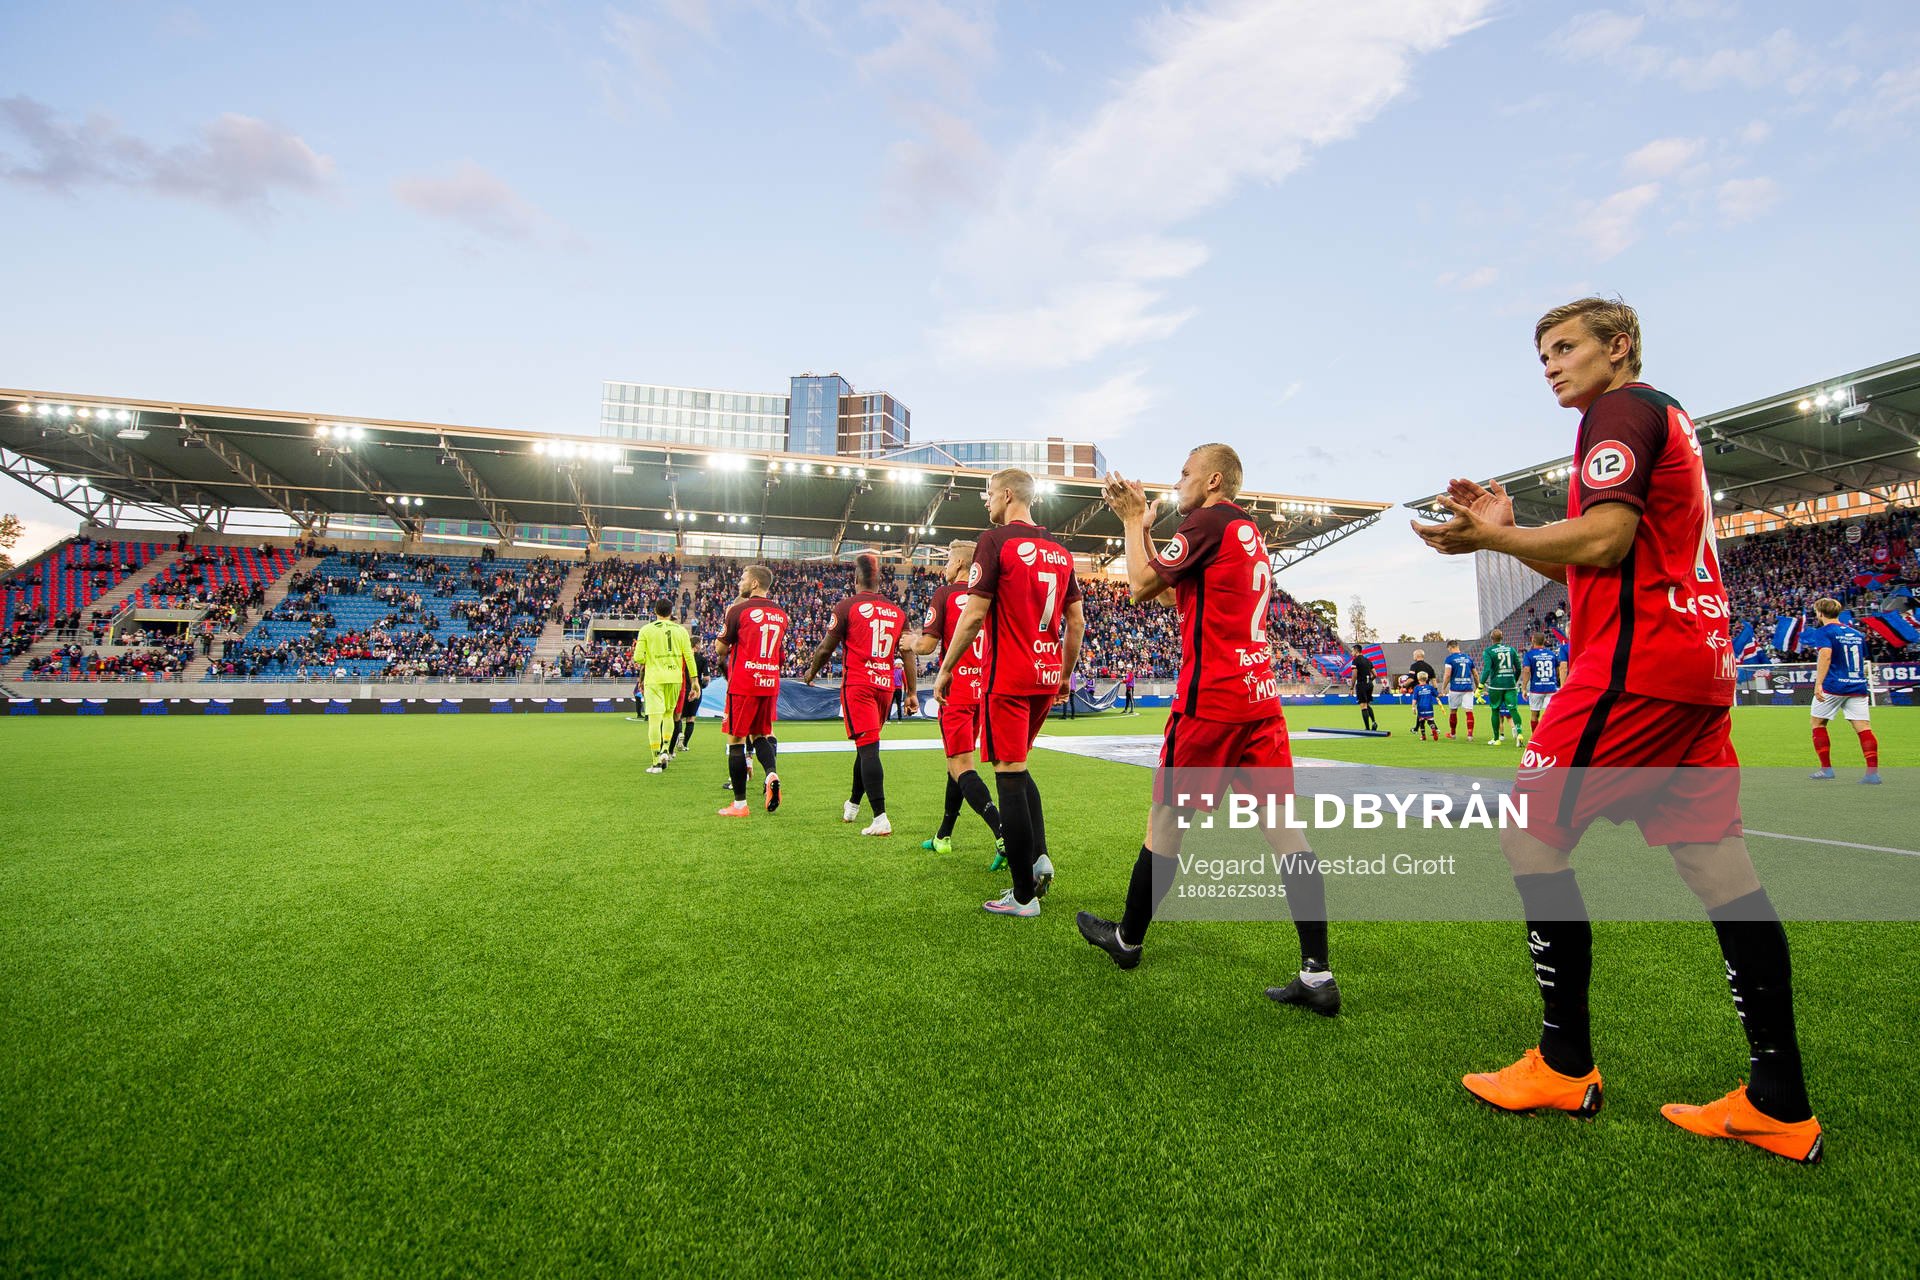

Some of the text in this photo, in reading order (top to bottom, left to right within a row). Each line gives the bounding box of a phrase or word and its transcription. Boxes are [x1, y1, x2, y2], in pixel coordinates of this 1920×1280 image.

[1592, 454, 1620, 475] 12
[1039, 549, 1067, 566] Telia
[1164, 541, 1181, 558] 12
[1038, 571, 1057, 632] 7
[1252, 561, 1271, 642] 2
[766, 612, 784, 623] Telia
[876, 606, 898, 618] Telia
[665, 630, 672, 651] 1
[760, 623, 780, 658] 17
[869, 618, 895, 658] 15
[1033, 640, 1059, 656] Orry
[1497, 651, 1512, 670] 21
[1843, 644, 1860, 672] 11
[1459, 662, 1467, 678] 7
[1535, 660, 1553, 679] 33
[1521, 748, 1551, 768] ØY
